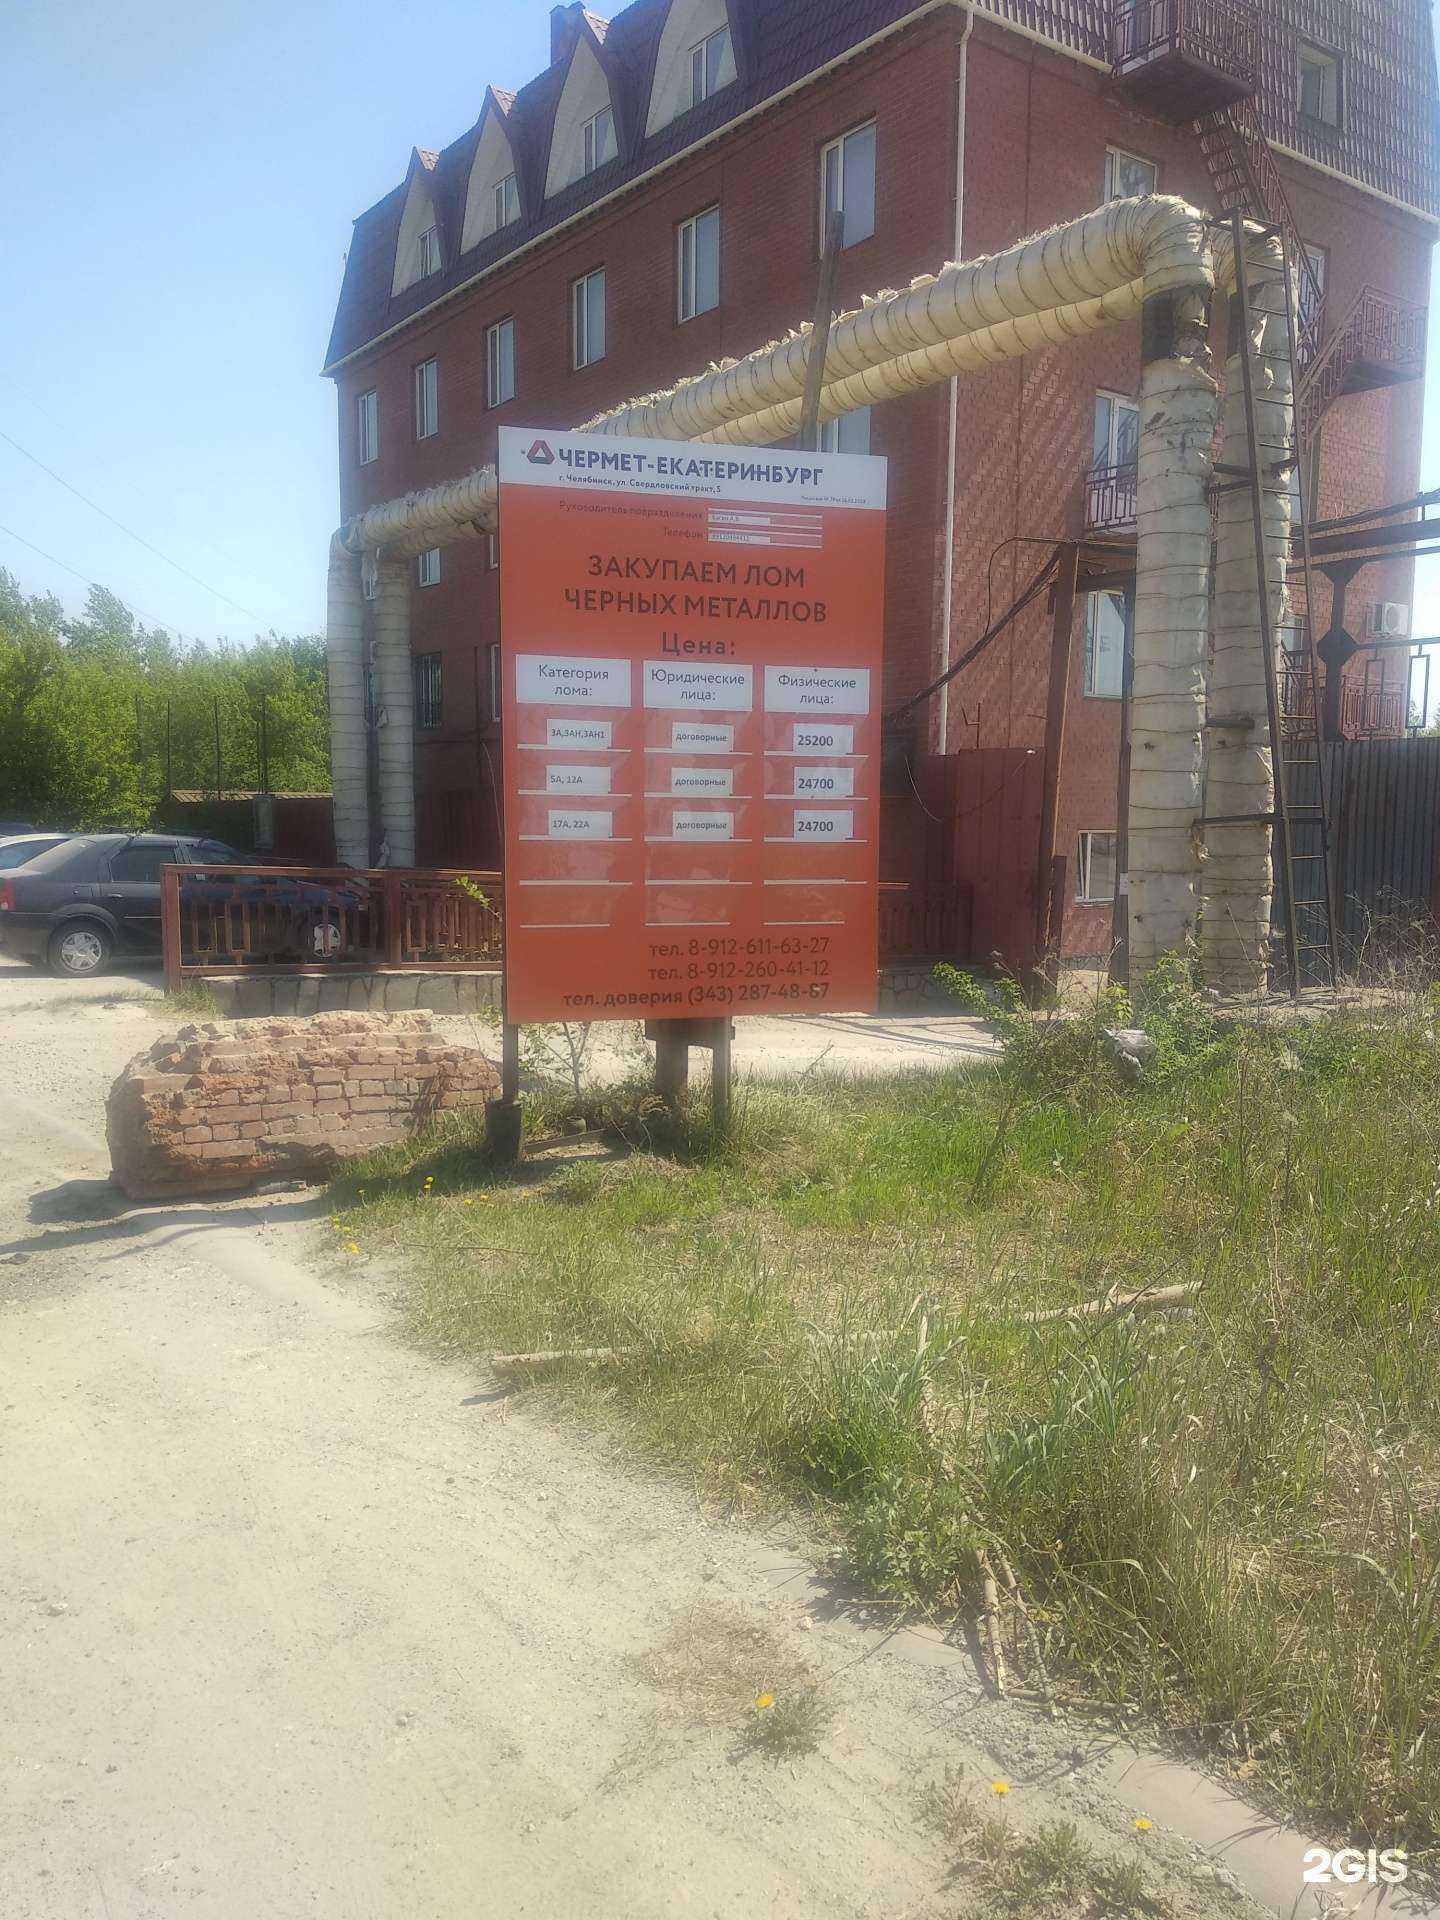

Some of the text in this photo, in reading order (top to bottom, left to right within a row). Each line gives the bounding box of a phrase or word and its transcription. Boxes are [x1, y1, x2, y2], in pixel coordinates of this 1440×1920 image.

[558, 448, 824, 486] ЧЕРМЕТ-ЕКАТЕРИНБУРГ
[566, 475, 615, 486] Челябинск,
[629, 479, 690, 491] Свердловский
[588, 555, 805, 588] ЗАКУПАЕМ ЛОМ
[564, 588, 827, 623] ЧЕРНЫХ МЕТАЛЛОВ
[661, 631, 736, 656] Цена:
[538, 664, 609, 681] Категория
[651, 668, 745, 685] Юридические
[778, 674, 857, 689] Физические
[554, 685, 593, 697] лома:
[679, 689, 717, 702] лица:
[799, 693, 834, 705] лица:
[675, 732, 727, 743] договорные
[797, 734, 834, 747] 25200
[675, 777, 726, 787] договорные
[797, 777, 834, 790] 24700
[676, 820, 727, 831] договорные
[797, 820, 834, 832] 24700
[649, 936, 830, 957] тел. 8-912-611-63-27
[648, 959, 829, 980] тел. 8-912-260-41-12
[563, 994, 598, 1006] тел.
[604, 992, 683, 1008] доверия
[687, 985, 733, 1005] (343)
